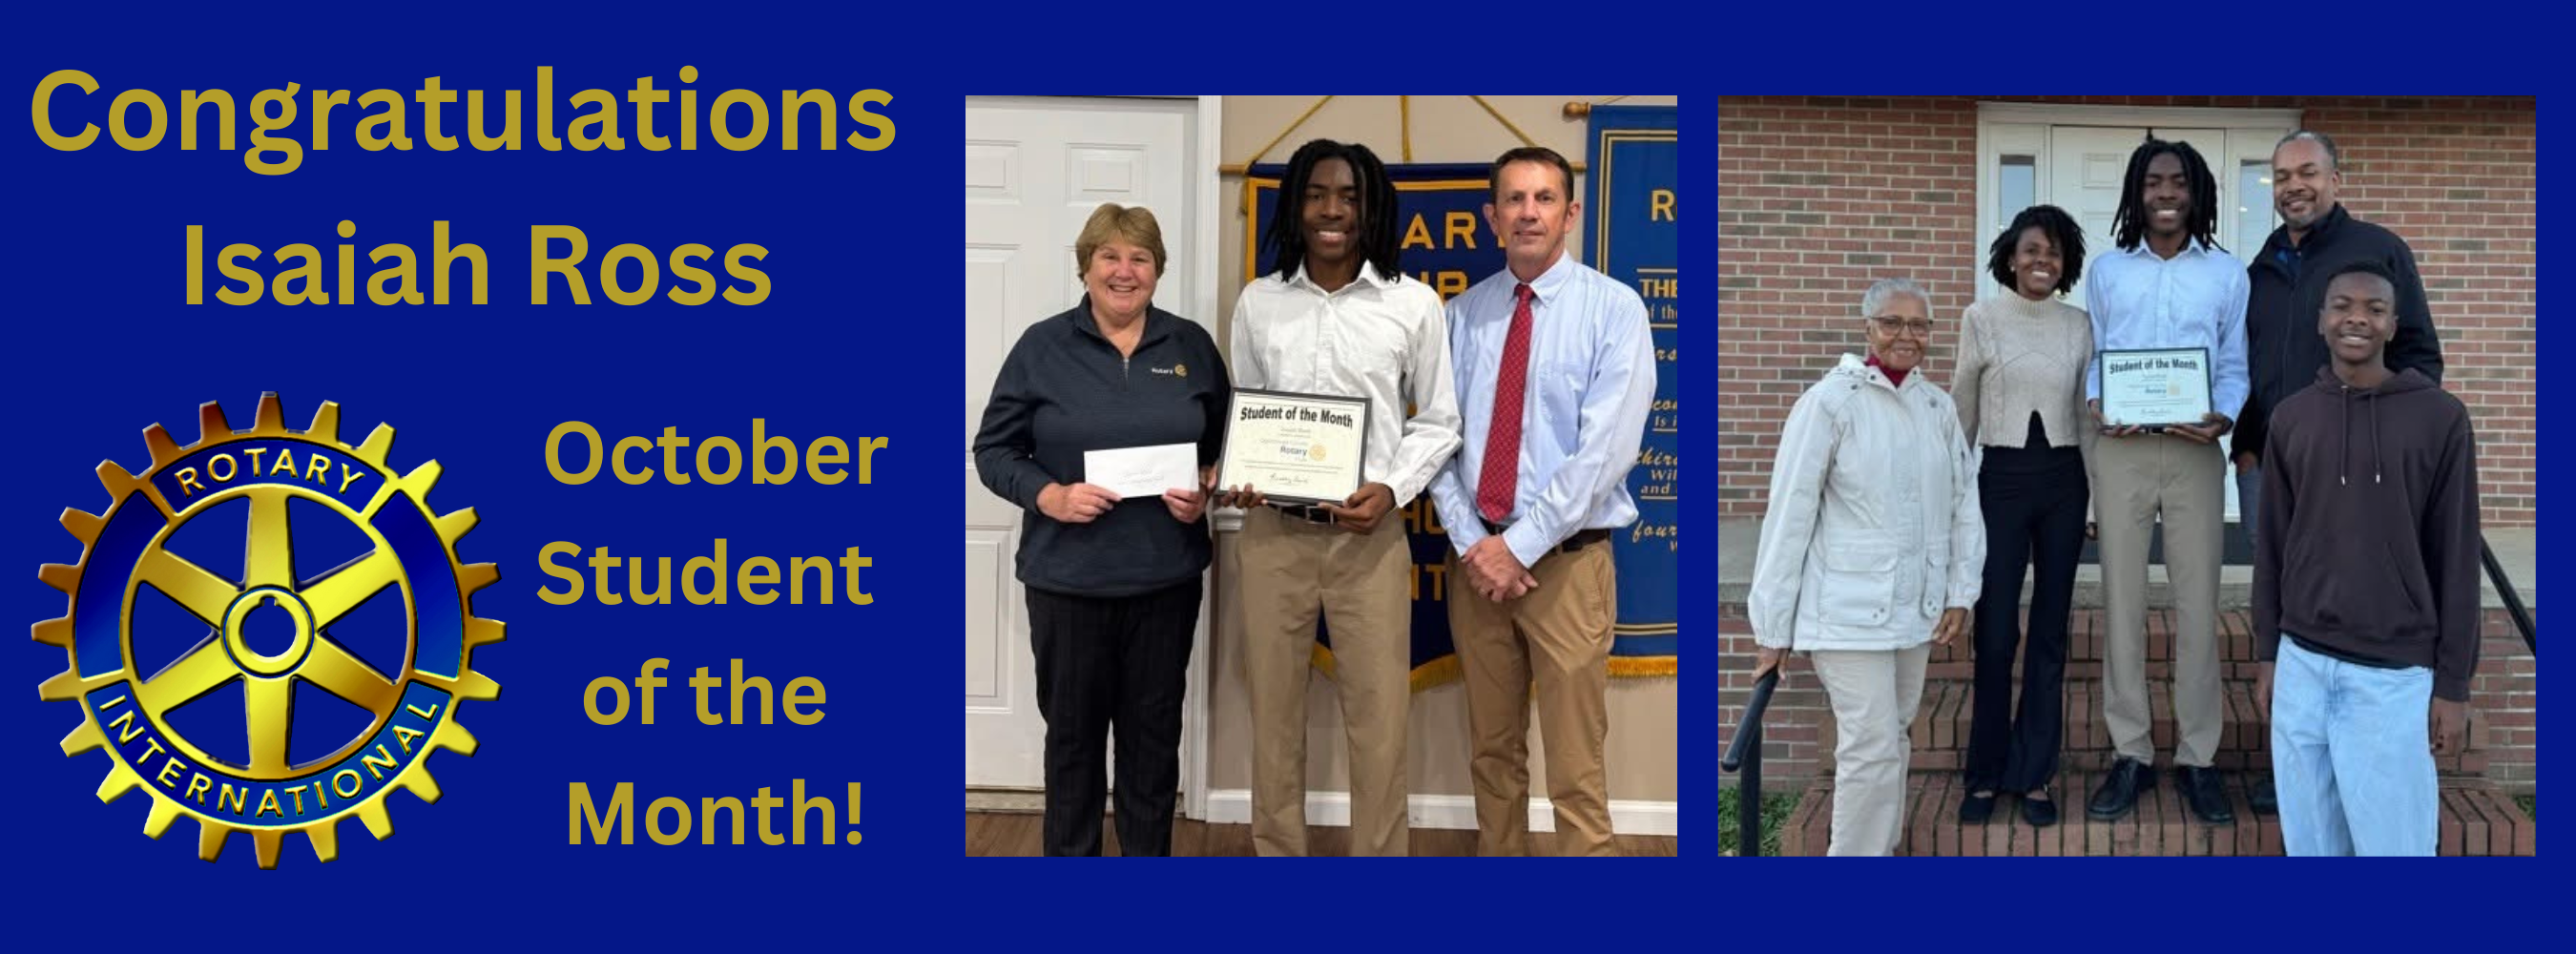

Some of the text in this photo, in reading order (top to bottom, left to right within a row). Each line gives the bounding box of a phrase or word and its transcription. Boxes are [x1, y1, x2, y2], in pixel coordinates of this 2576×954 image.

[1652, 190, 1677, 221] R
[1401, 211, 1506, 250] AR
[2109, 358, 2198, 375] Student of the Month
[1240, 406, 1353, 430] Student of the Month
[1280, 446, 1307, 456] Rotary
[1641, 482, 1670, 494] and
